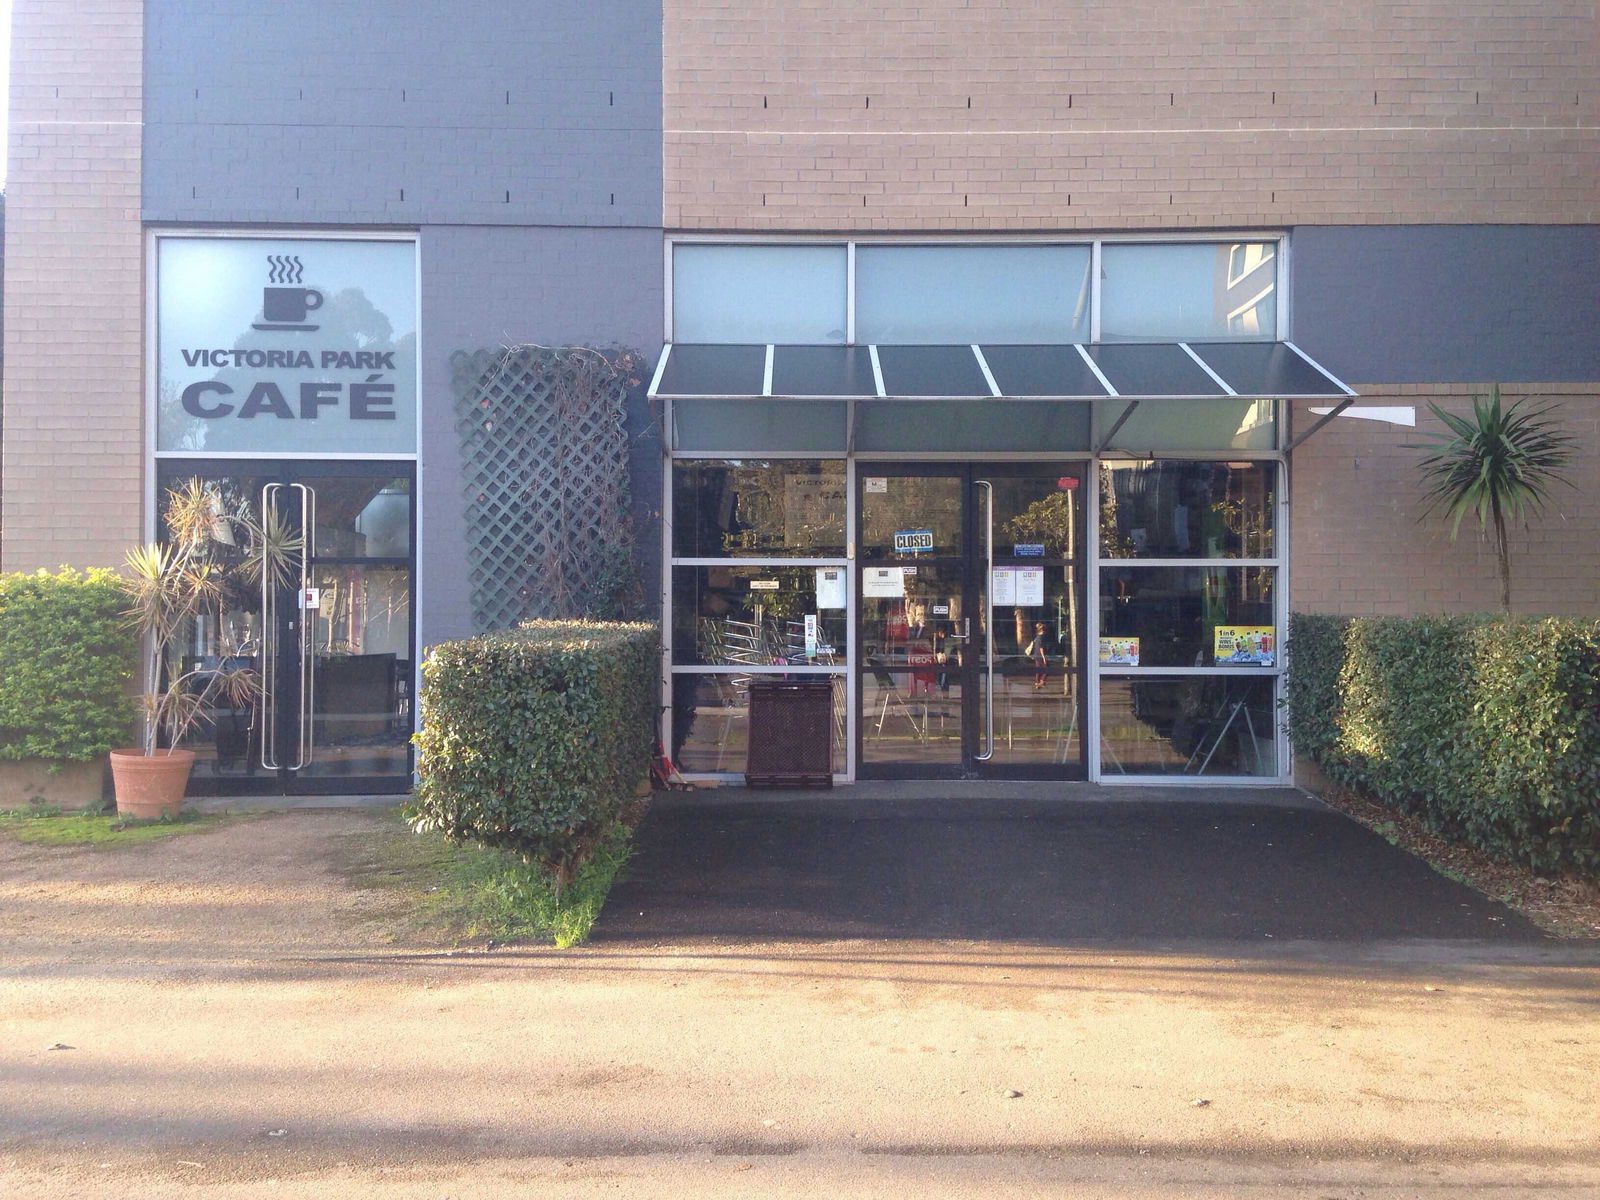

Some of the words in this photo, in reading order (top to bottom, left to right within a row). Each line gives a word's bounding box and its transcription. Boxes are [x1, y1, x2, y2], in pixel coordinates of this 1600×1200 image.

[181, 349, 314, 368] VICTORIA
[321, 351, 396, 370] PARK
[181, 374, 396, 420] CAFÉ
[896, 535, 931, 548] CLOSED
